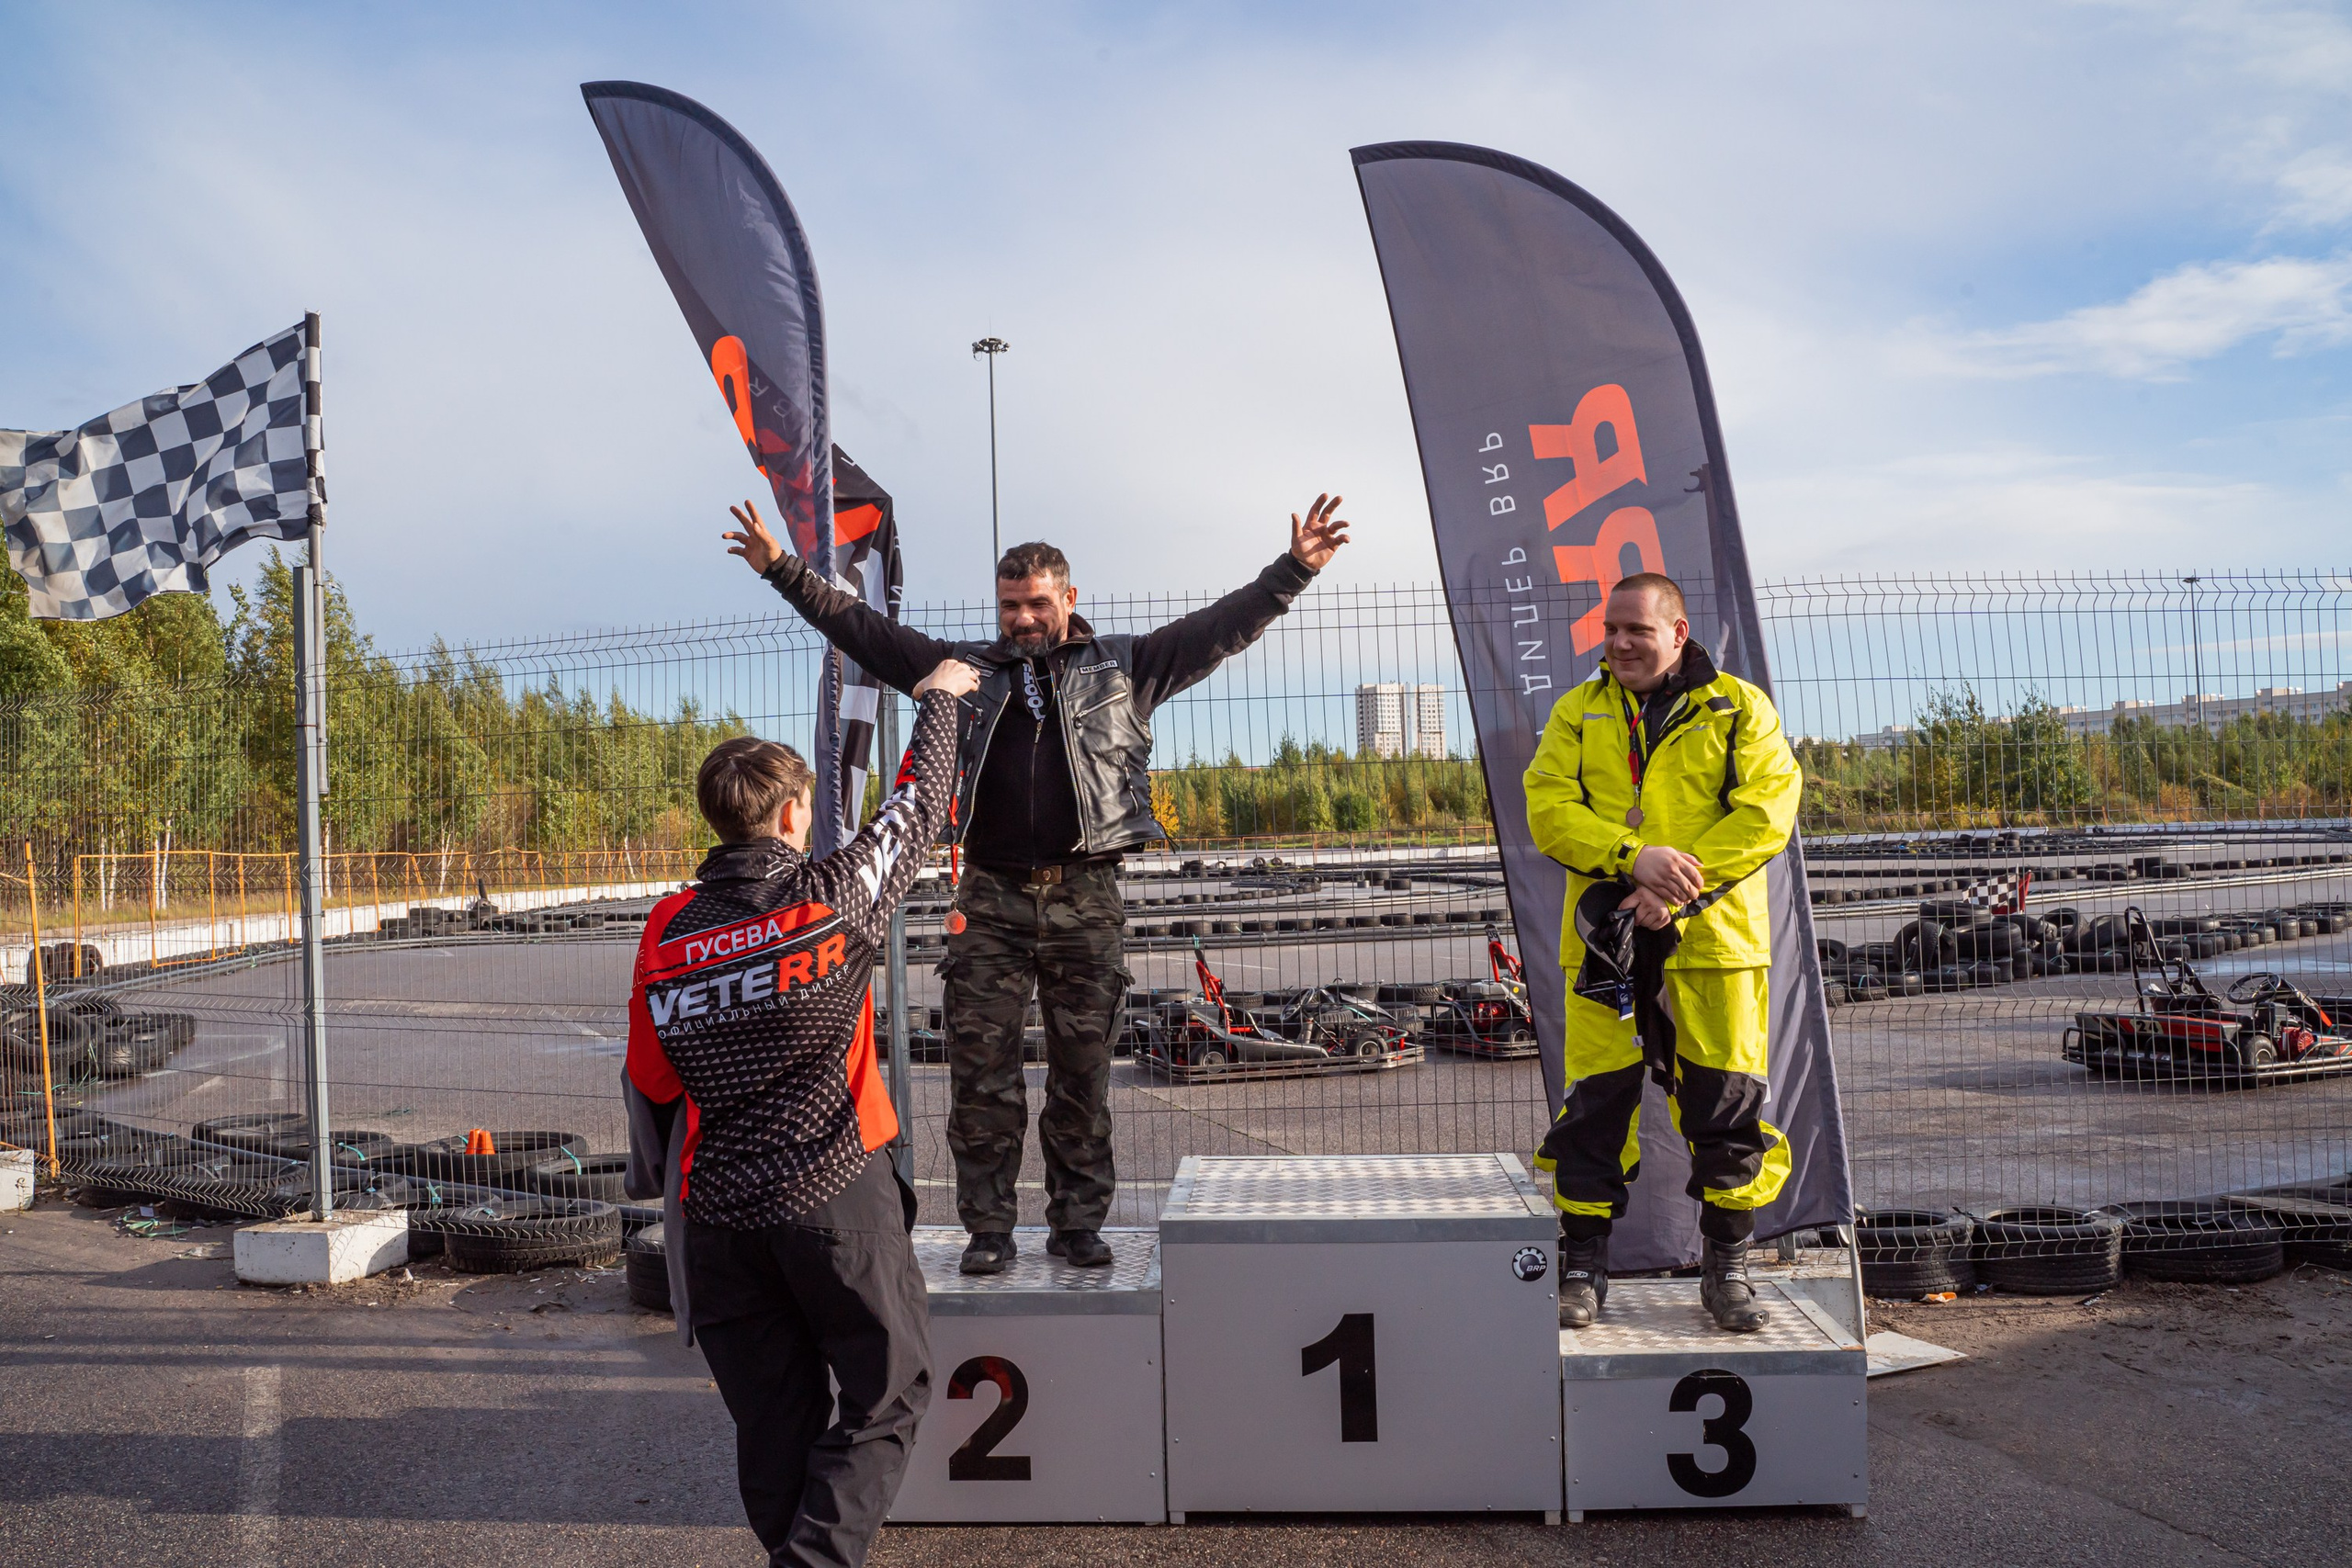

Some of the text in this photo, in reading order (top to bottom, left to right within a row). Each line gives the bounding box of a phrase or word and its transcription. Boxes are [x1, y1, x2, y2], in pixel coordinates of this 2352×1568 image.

[1081, 661, 1115, 672] MEMBER
[650, 932, 846, 1026] VETERR
[684, 919, 784, 964] ГУСЕВА
[658, 964, 849, 1040] ОФИЦИАЛЬНЫЙ ДИЛЕР
[2135, 1021, 2159, 1033] 24
[1525, 1264, 1546, 1273] BRP
[1301, 1314, 1377, 1442] 1
[946, 1356, 1031, 1482] 2
[1667, 1369, 1757, 1498] 3
